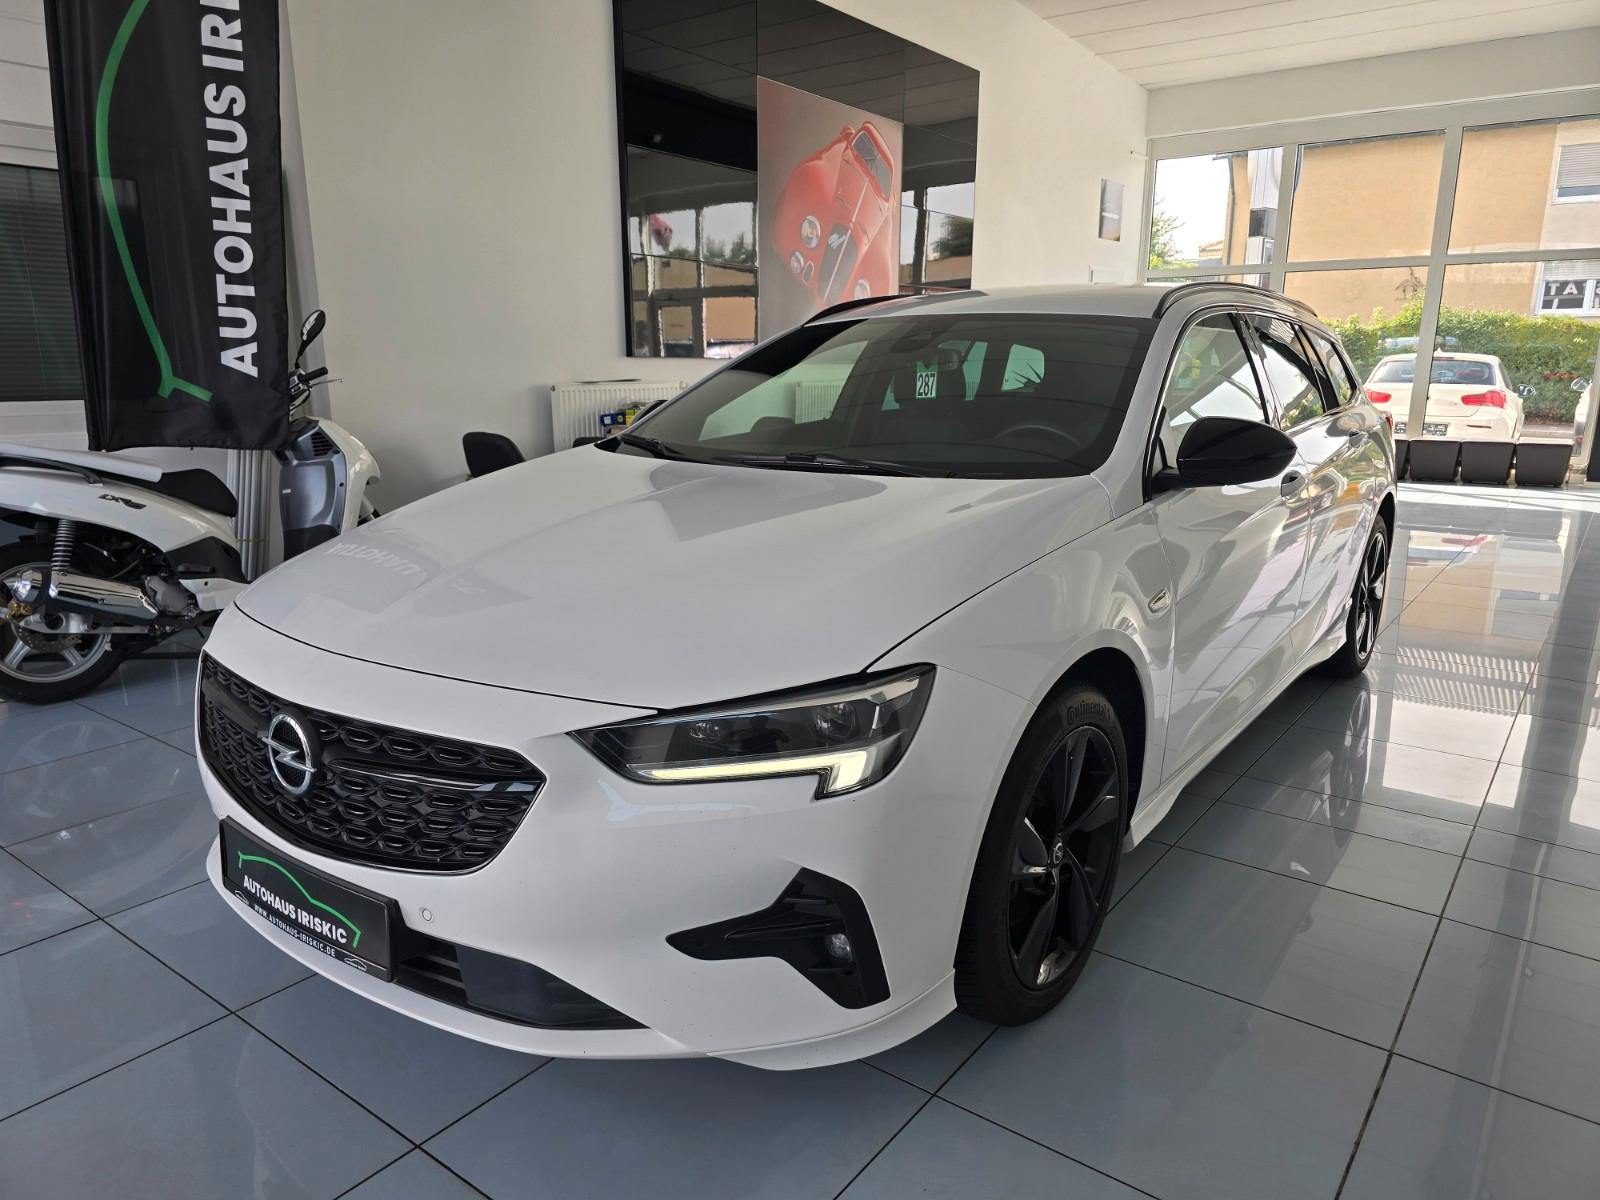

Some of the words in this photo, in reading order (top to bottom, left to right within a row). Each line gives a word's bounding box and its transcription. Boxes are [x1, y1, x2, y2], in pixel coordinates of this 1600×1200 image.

[203, 82, 259, 378] AUTOHAUS
[917, 373, 936, 397] 287
[243, 875, 296, 920] AUTOHAUS
[297, 908, 347, 944] IRISKIC
